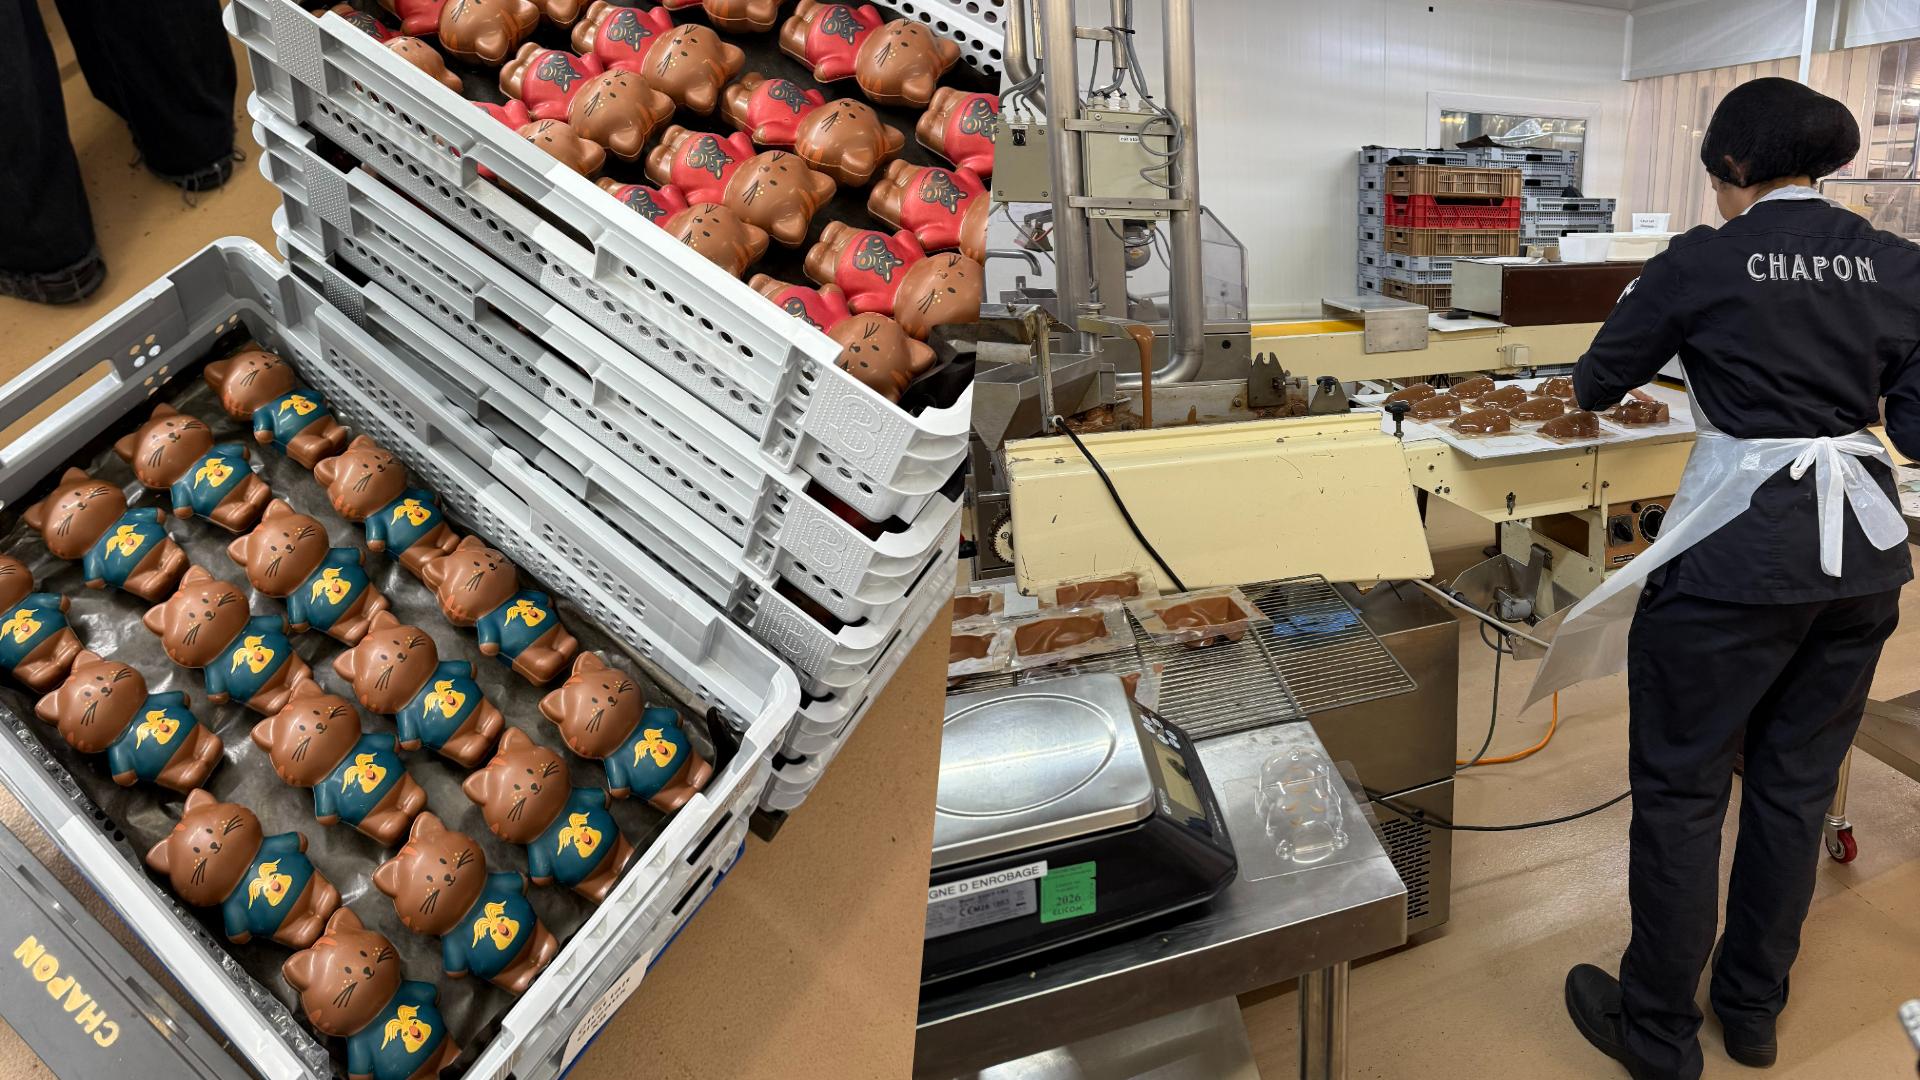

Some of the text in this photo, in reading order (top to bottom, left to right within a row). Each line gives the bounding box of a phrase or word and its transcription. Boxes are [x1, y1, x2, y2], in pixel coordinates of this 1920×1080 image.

[1746, 252, 1878, 282] CHAPON
[959, 882, 969, 894] D
[972, 865, 1040, 890] ENROBAGE
[1055, 893, 1082, 907] 2026
[13, 935, 120, 1048] CHAPON
